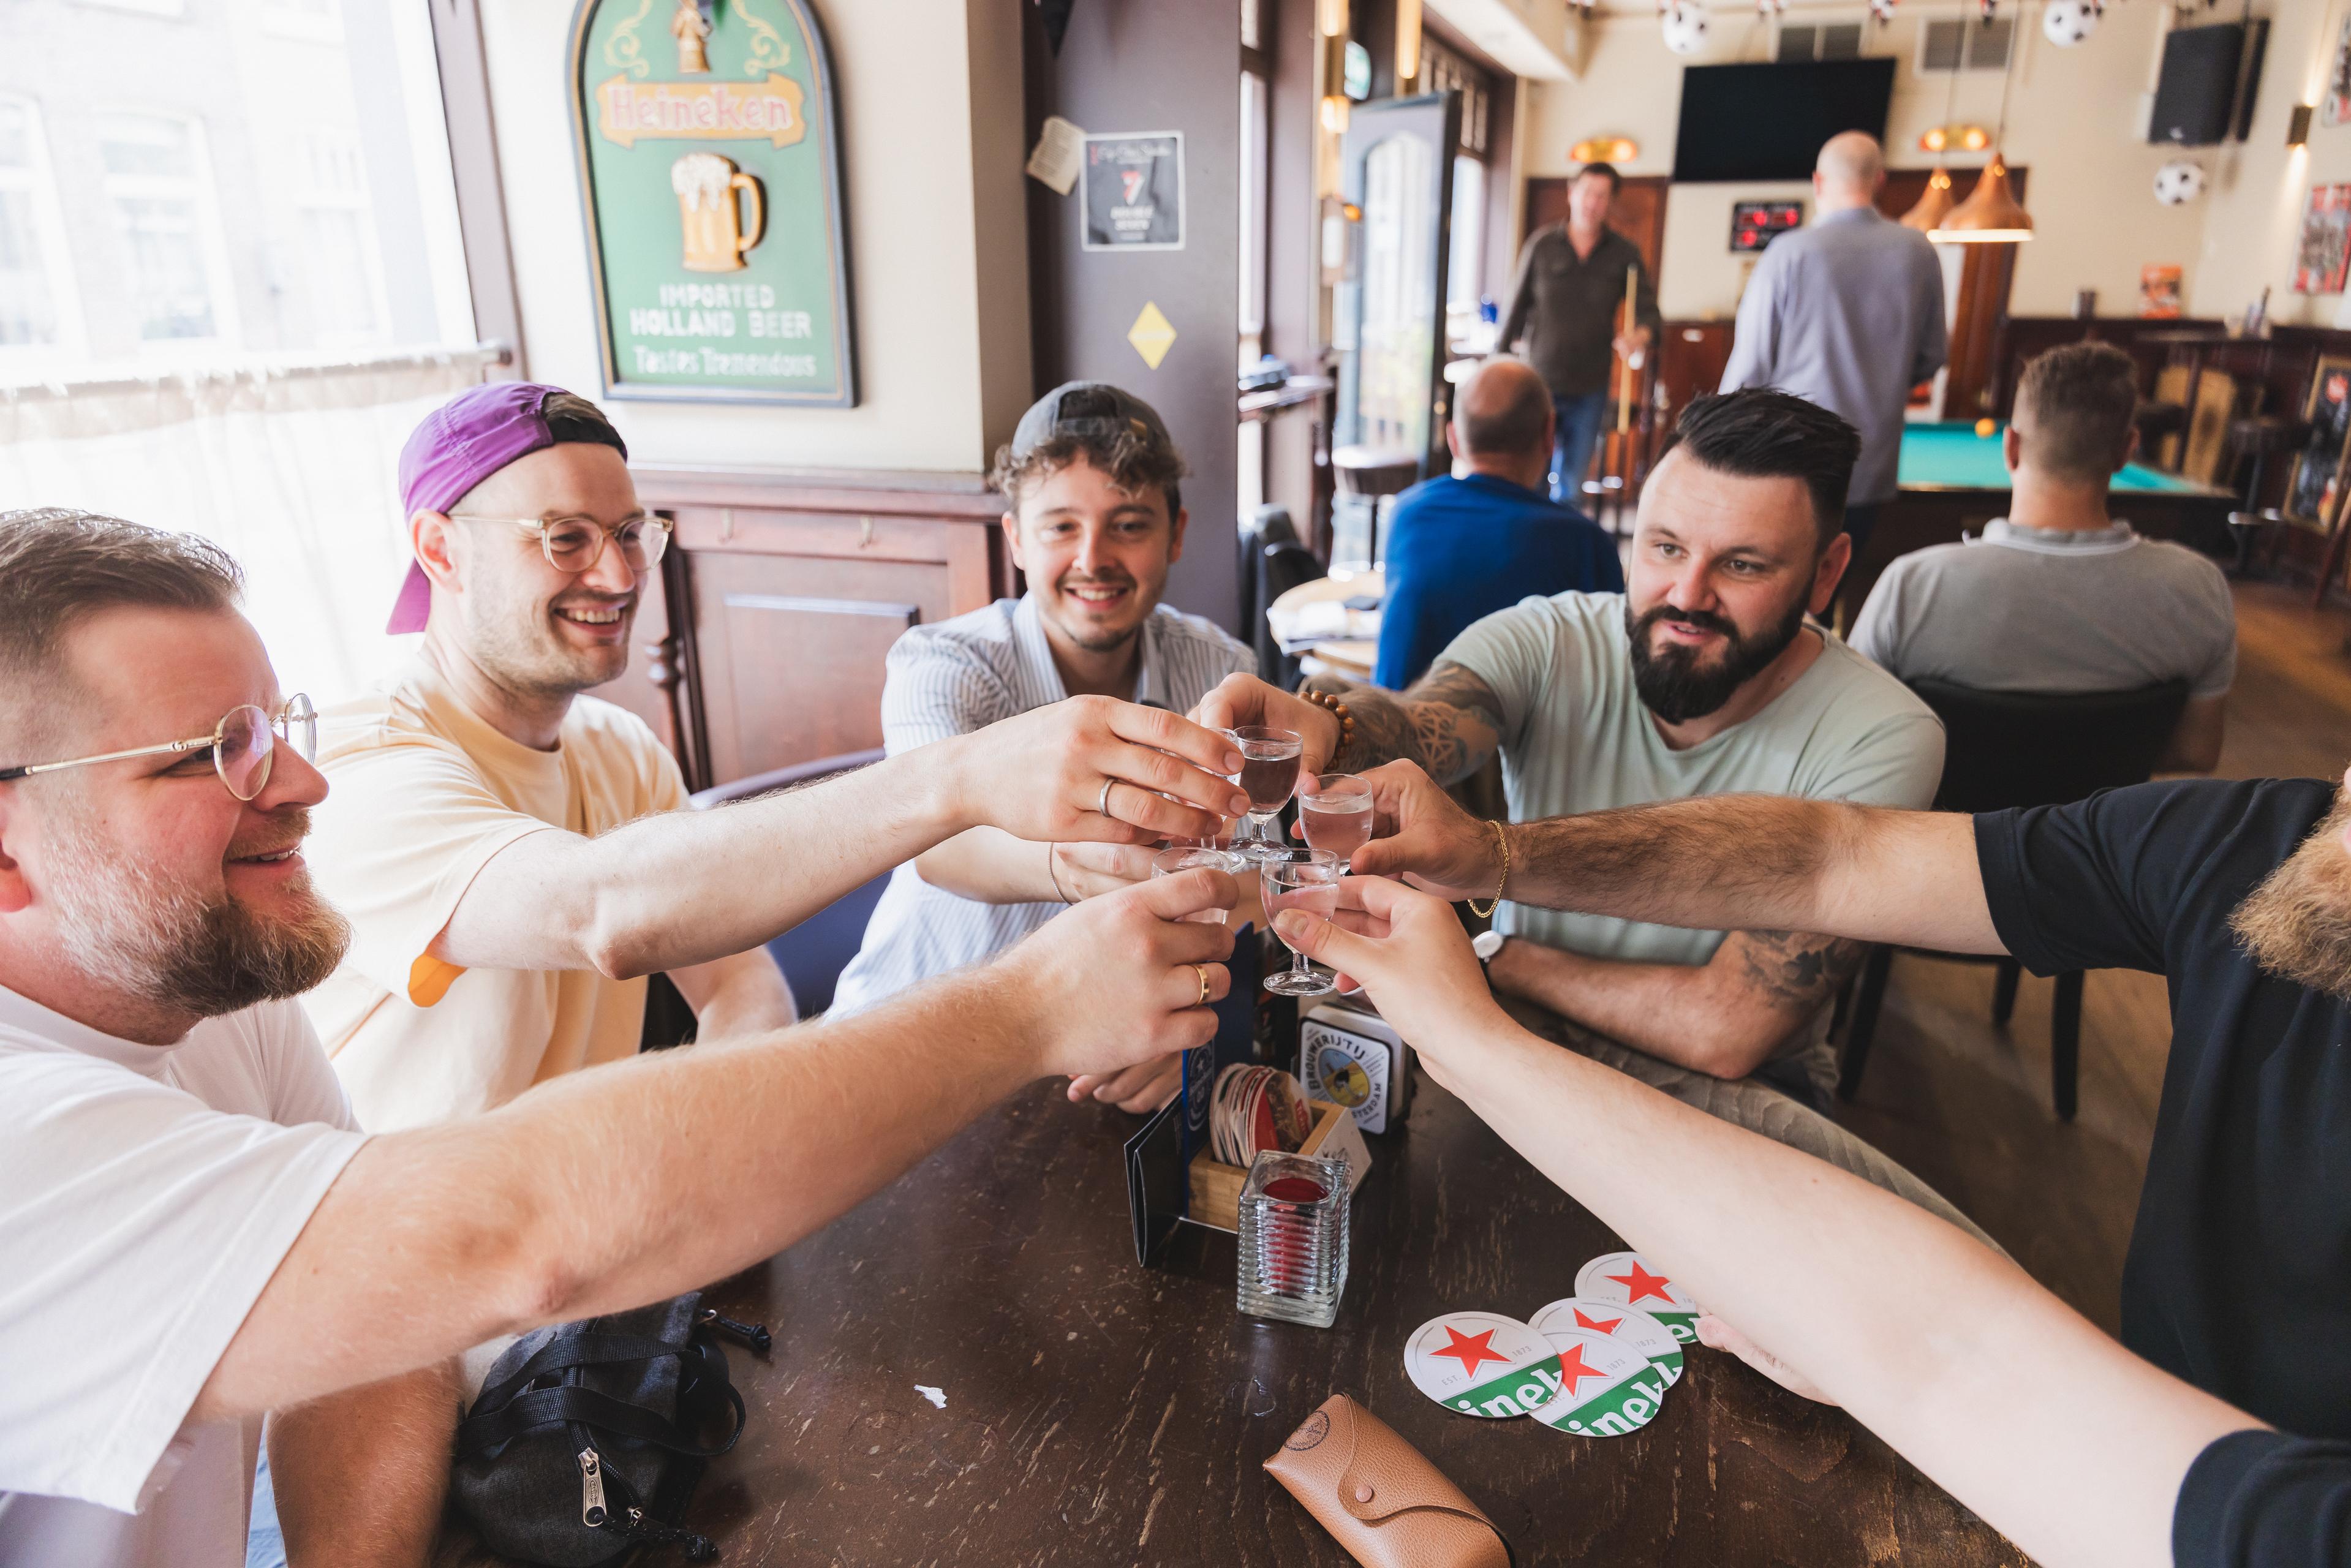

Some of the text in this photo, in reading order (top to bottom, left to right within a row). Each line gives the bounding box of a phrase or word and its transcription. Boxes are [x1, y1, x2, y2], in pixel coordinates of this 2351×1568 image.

[607, 85, 793, 130] Heineken
[659, 284, 775, 309] IMPORTED
[629, 308, 812, 337] HOLLAND BEER
[1305, 1034, 1340, 1090] BROUWERIJ
[1352, 1082, 1381, 1118] STERDAM
[1512, 1346, 1533, 1357] 1873
[1635, 1338, 1657, 1348] 1873
[1607, 1358, 1626, 1371] 1873
[1441, 1374, 1463, 1387] EST.
